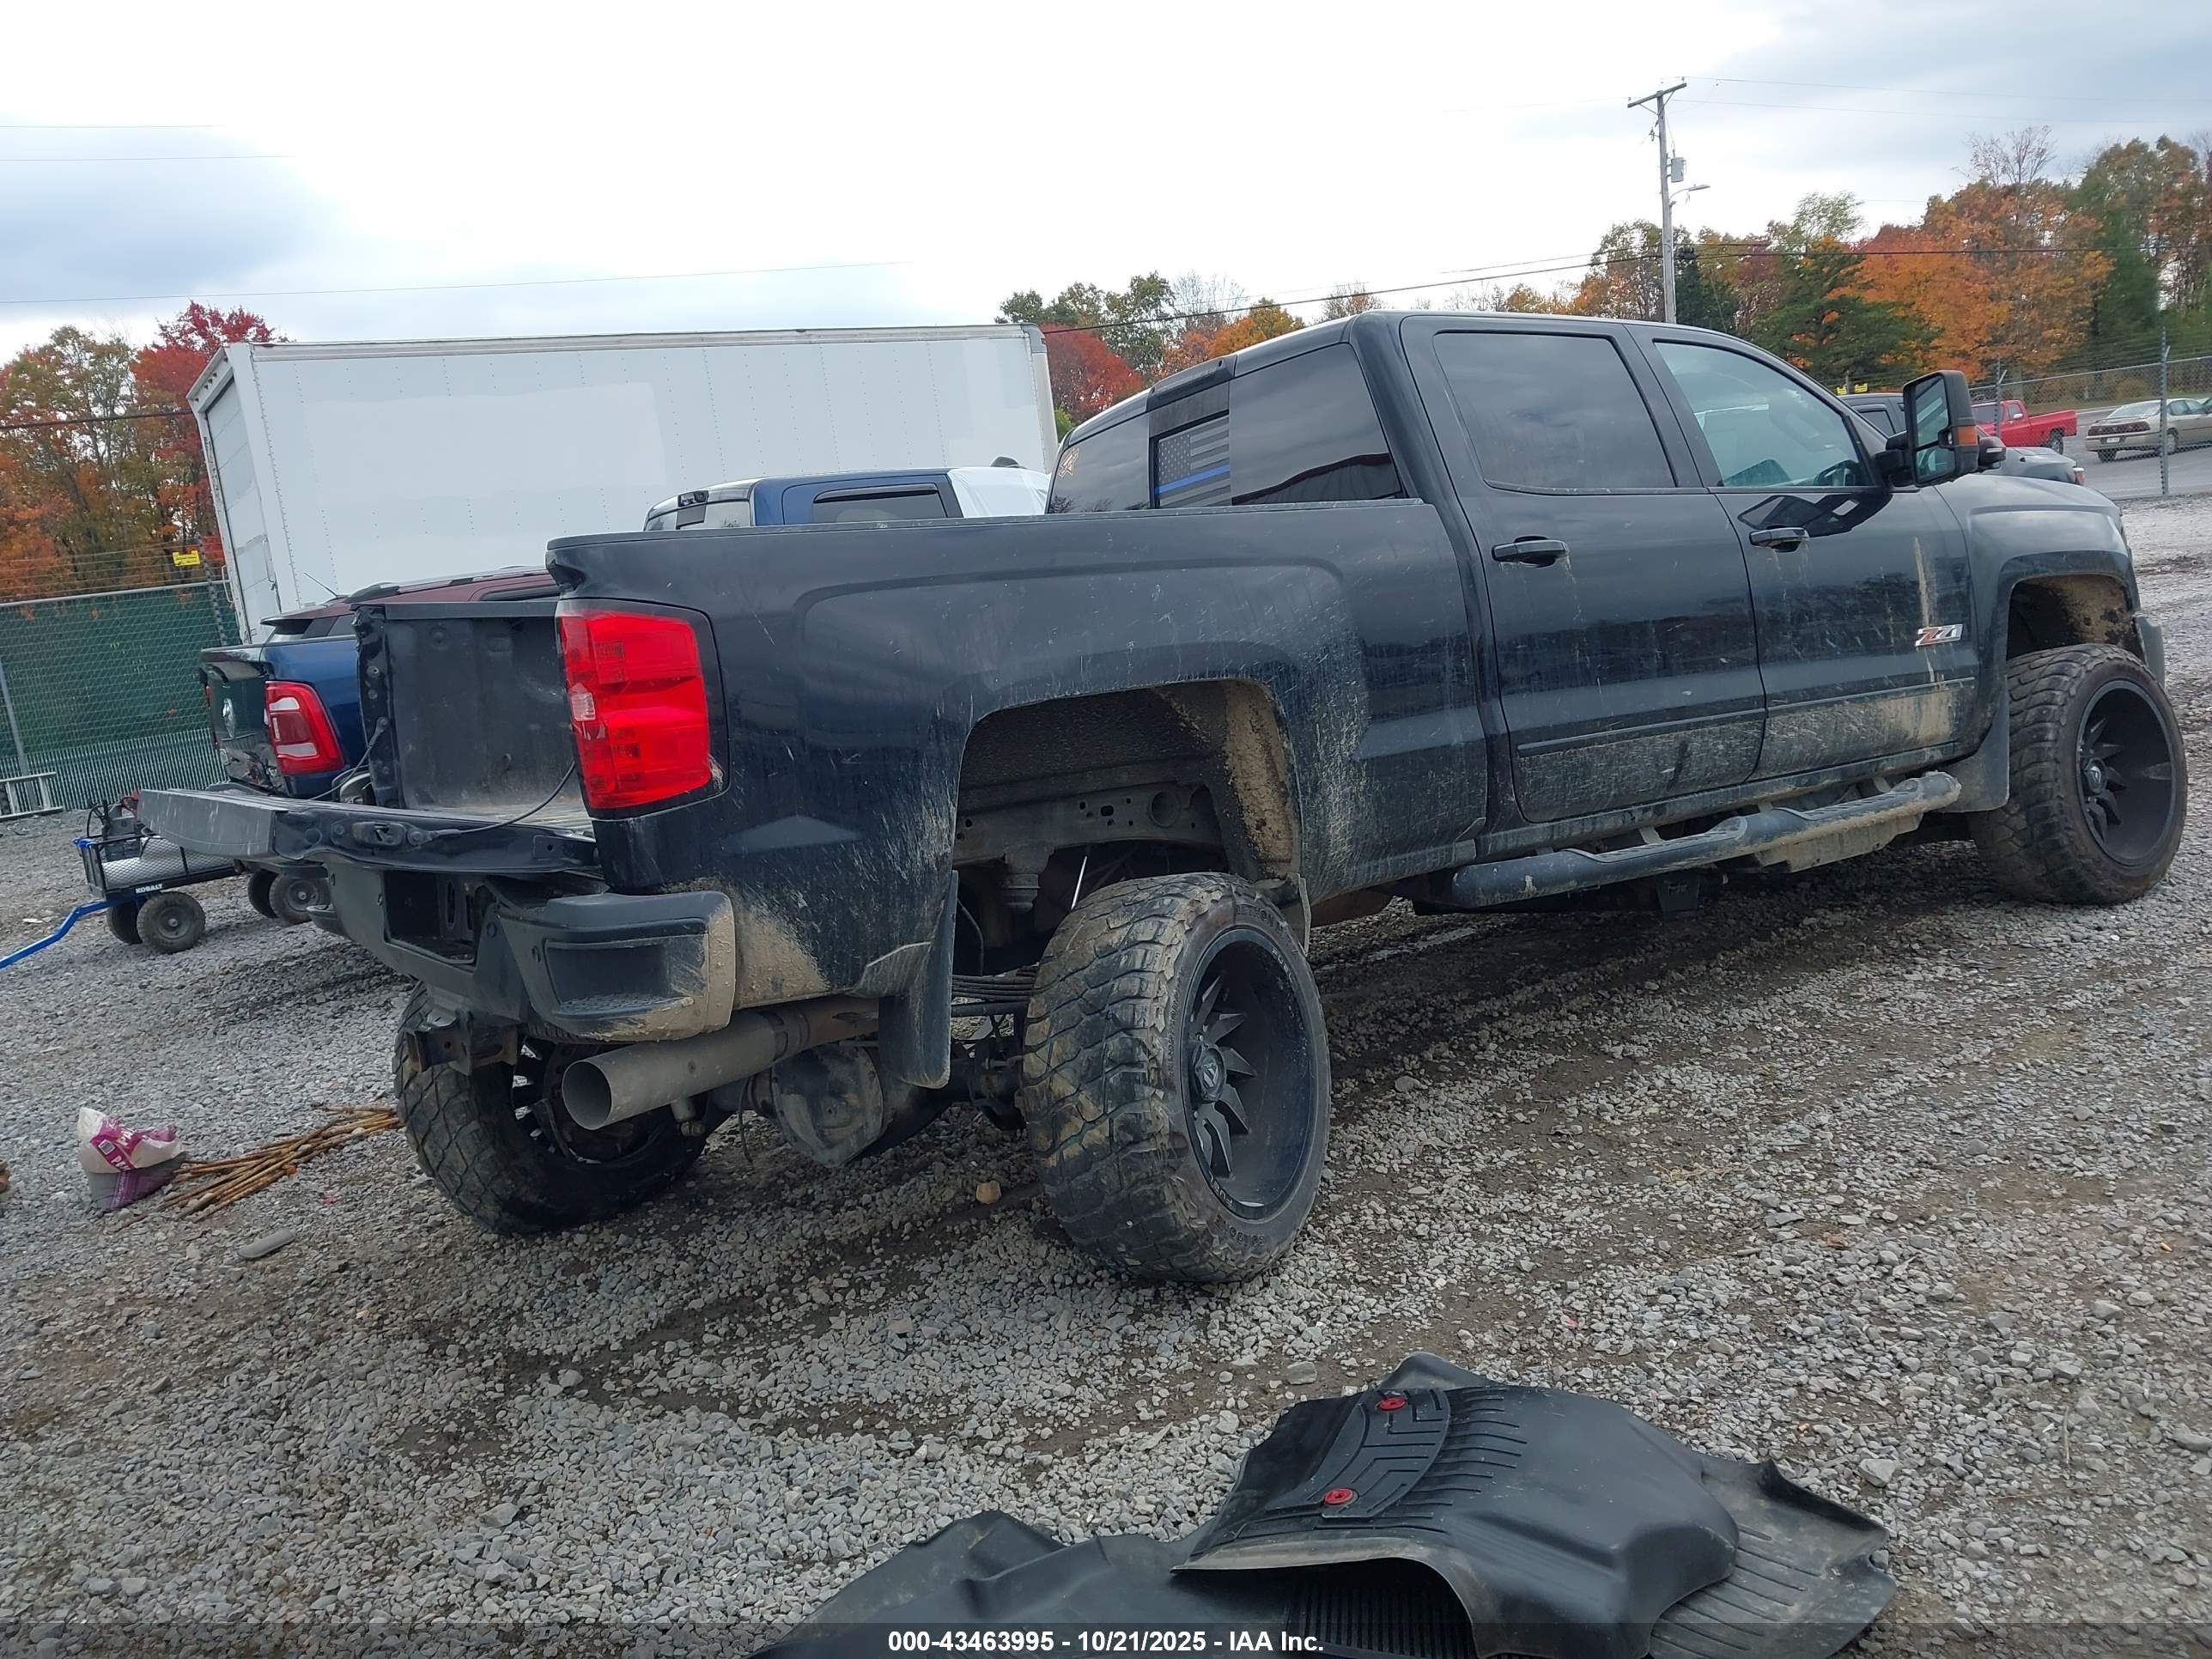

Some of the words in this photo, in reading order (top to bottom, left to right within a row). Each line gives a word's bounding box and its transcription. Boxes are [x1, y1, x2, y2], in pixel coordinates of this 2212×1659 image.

[1915, 623, 1964, 647] Z71
[135, 884, 163, 894] KOBALT
[1271, 947, 1293, 983] FUEL
[1208, 1170, 1233, 1206] FUEL
